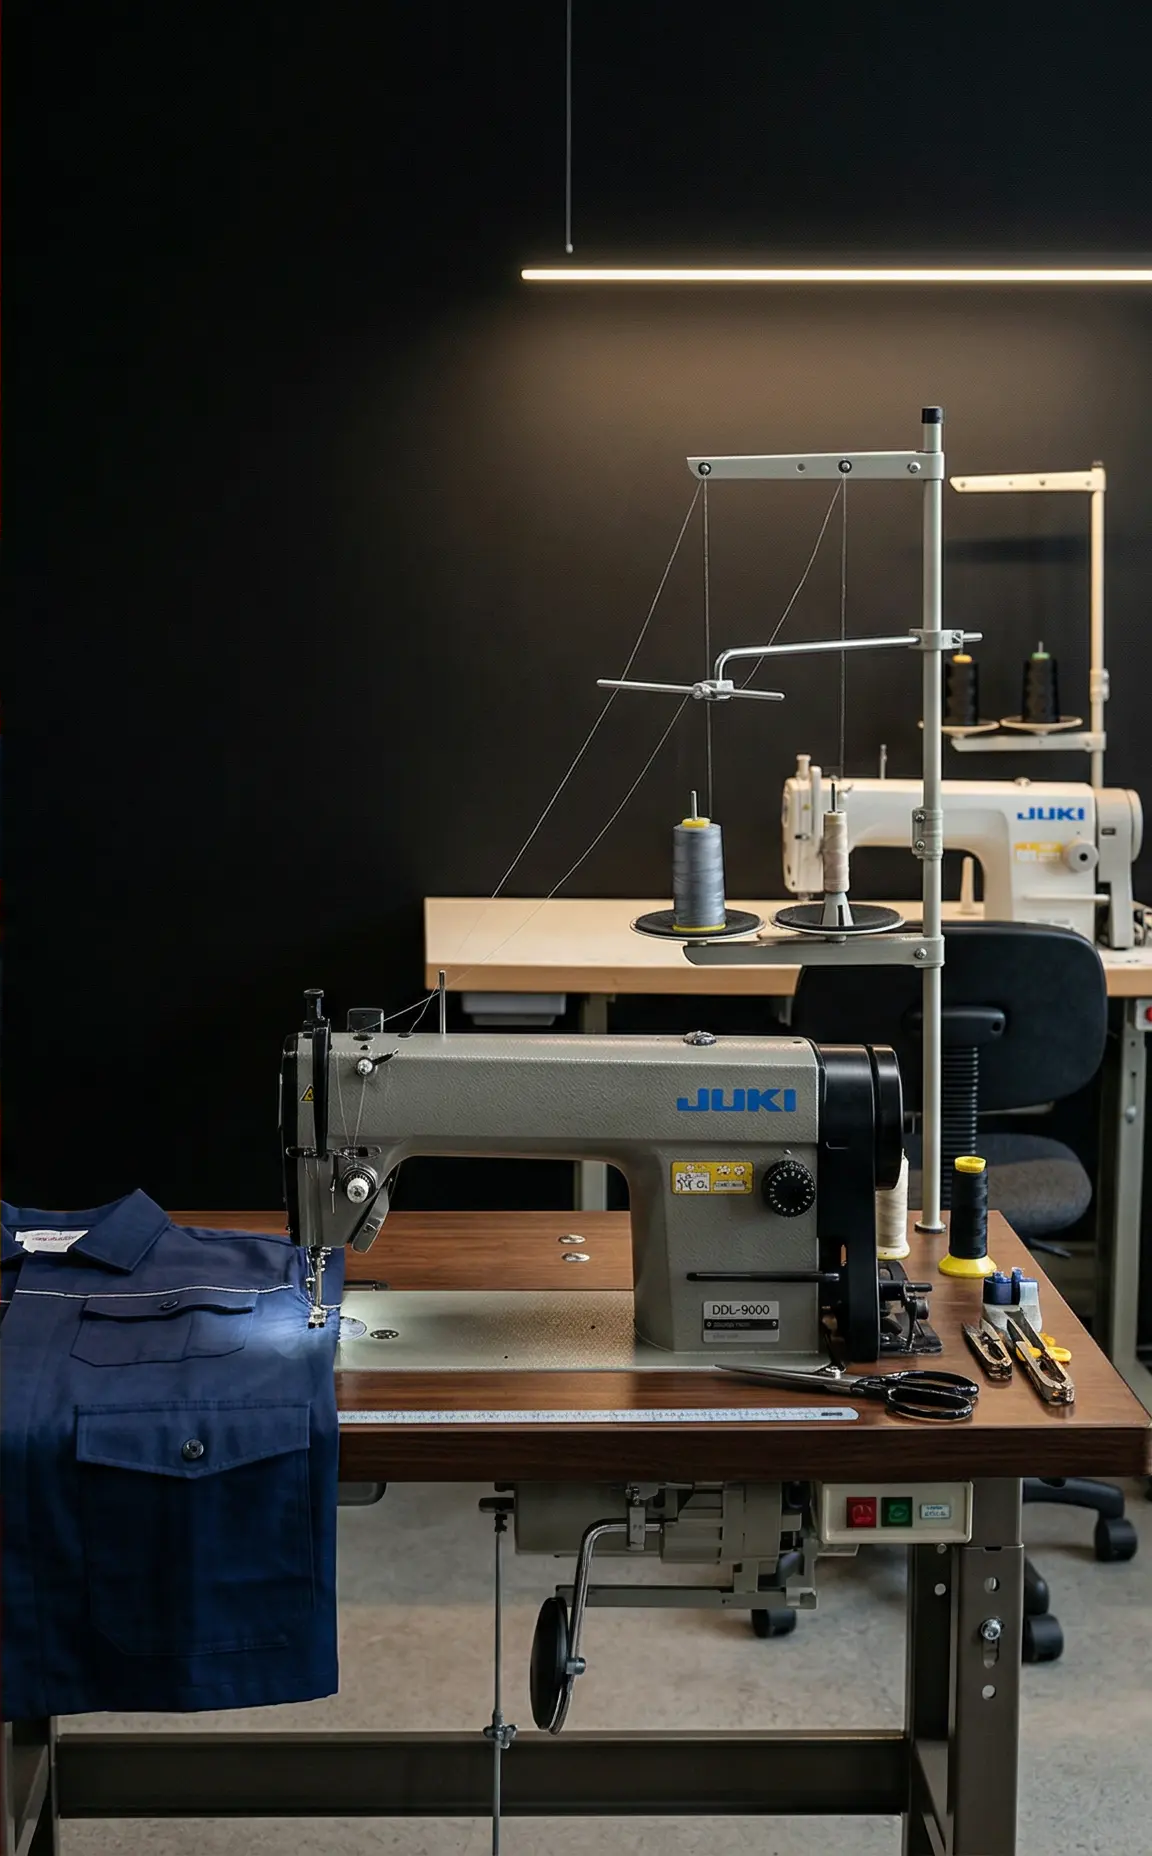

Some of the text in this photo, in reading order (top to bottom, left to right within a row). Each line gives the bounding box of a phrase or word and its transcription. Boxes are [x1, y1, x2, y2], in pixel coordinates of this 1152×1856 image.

[1017, 807, 1085, 821] JUKI
[676, 1088, 796, 1113] JUKI
[712, 1304, 770, 1315] DDL-9000
